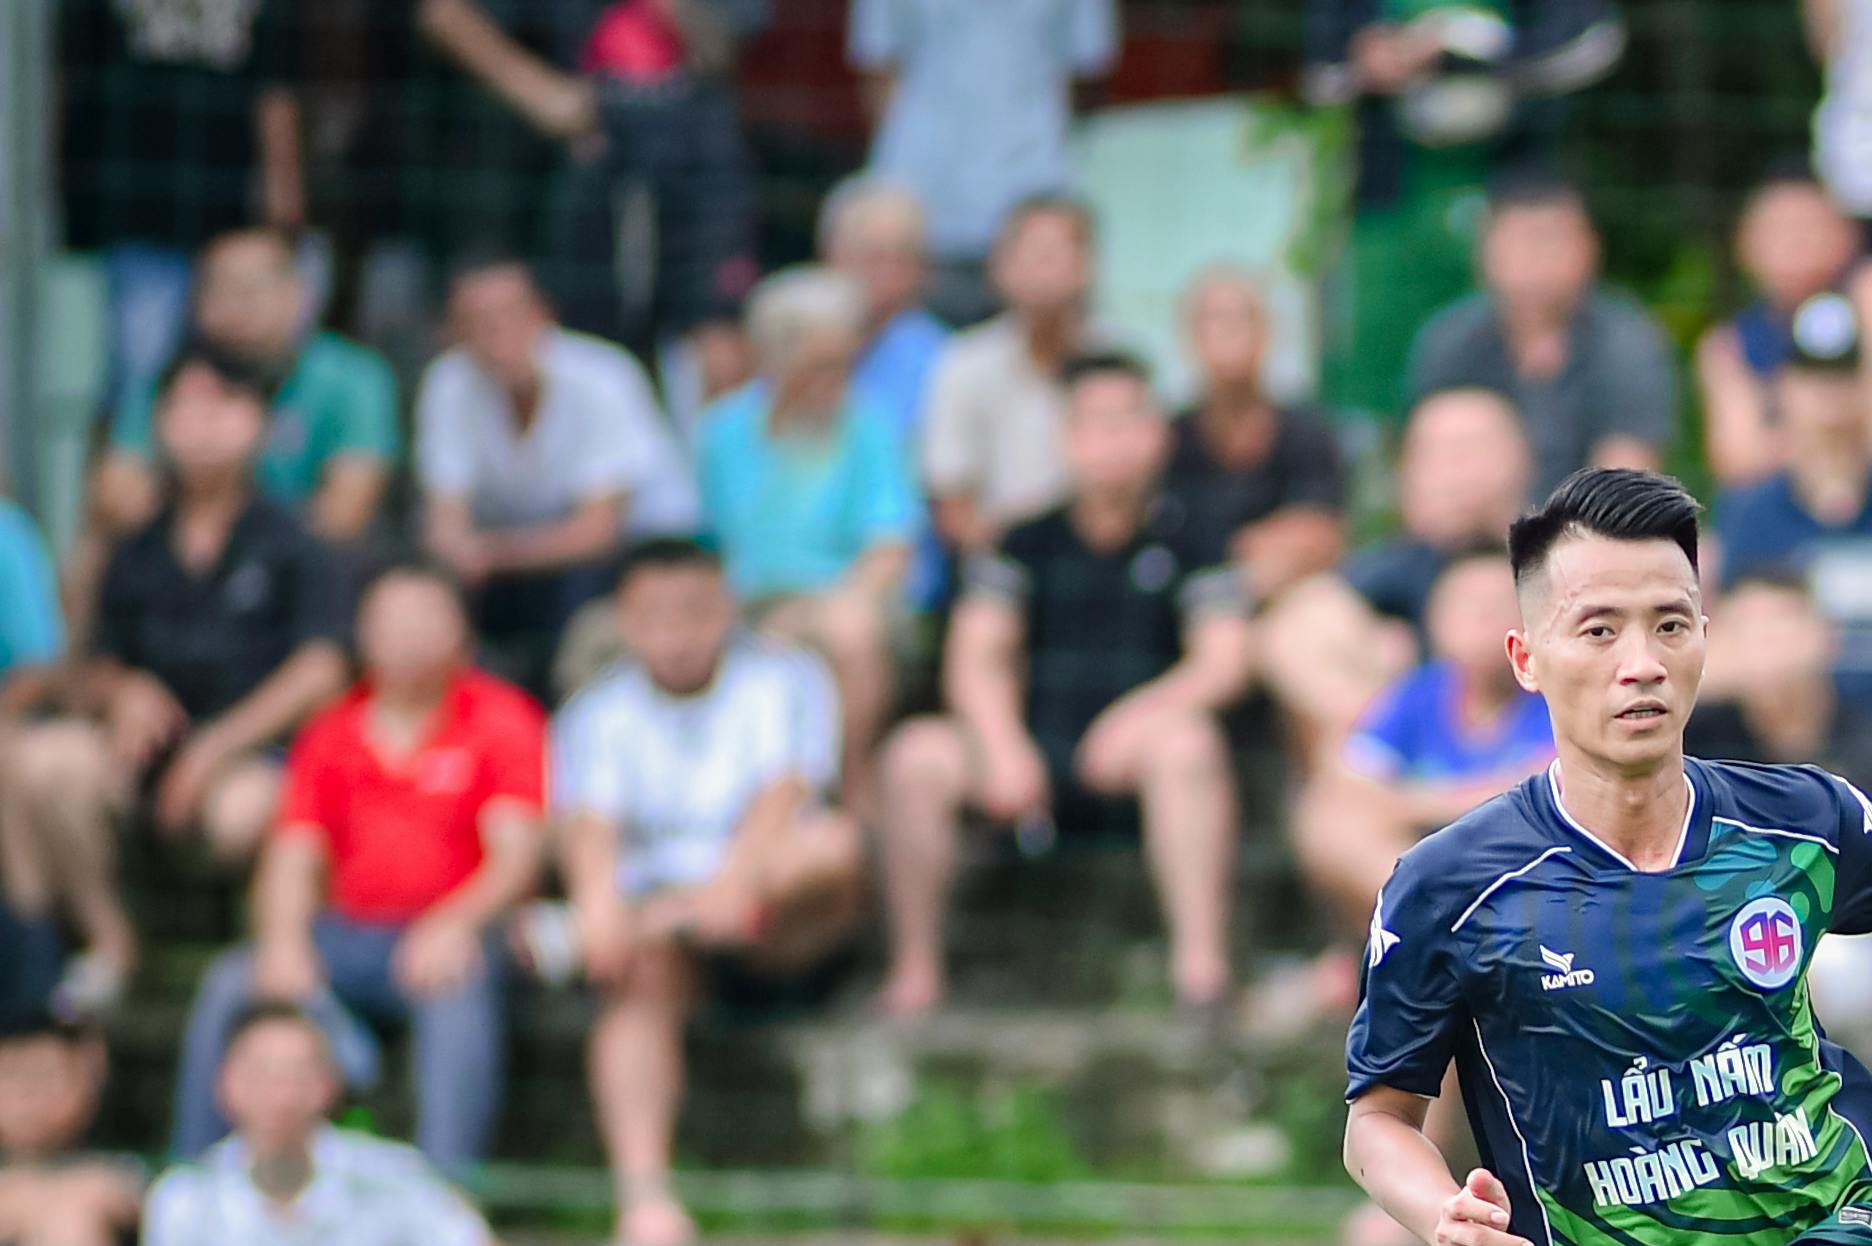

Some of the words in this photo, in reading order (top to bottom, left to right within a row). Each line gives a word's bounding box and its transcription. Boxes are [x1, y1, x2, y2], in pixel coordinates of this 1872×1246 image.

[1740, 909, 1797, 976] 96
[1541, 968, 1595, 991] KAMITO
[1601, 1056, 1675, 1128] LẨU
[1690, 1033, 1775, 1107] NẤM
[1583, 1140, 1721, 1207] HOÀNG
